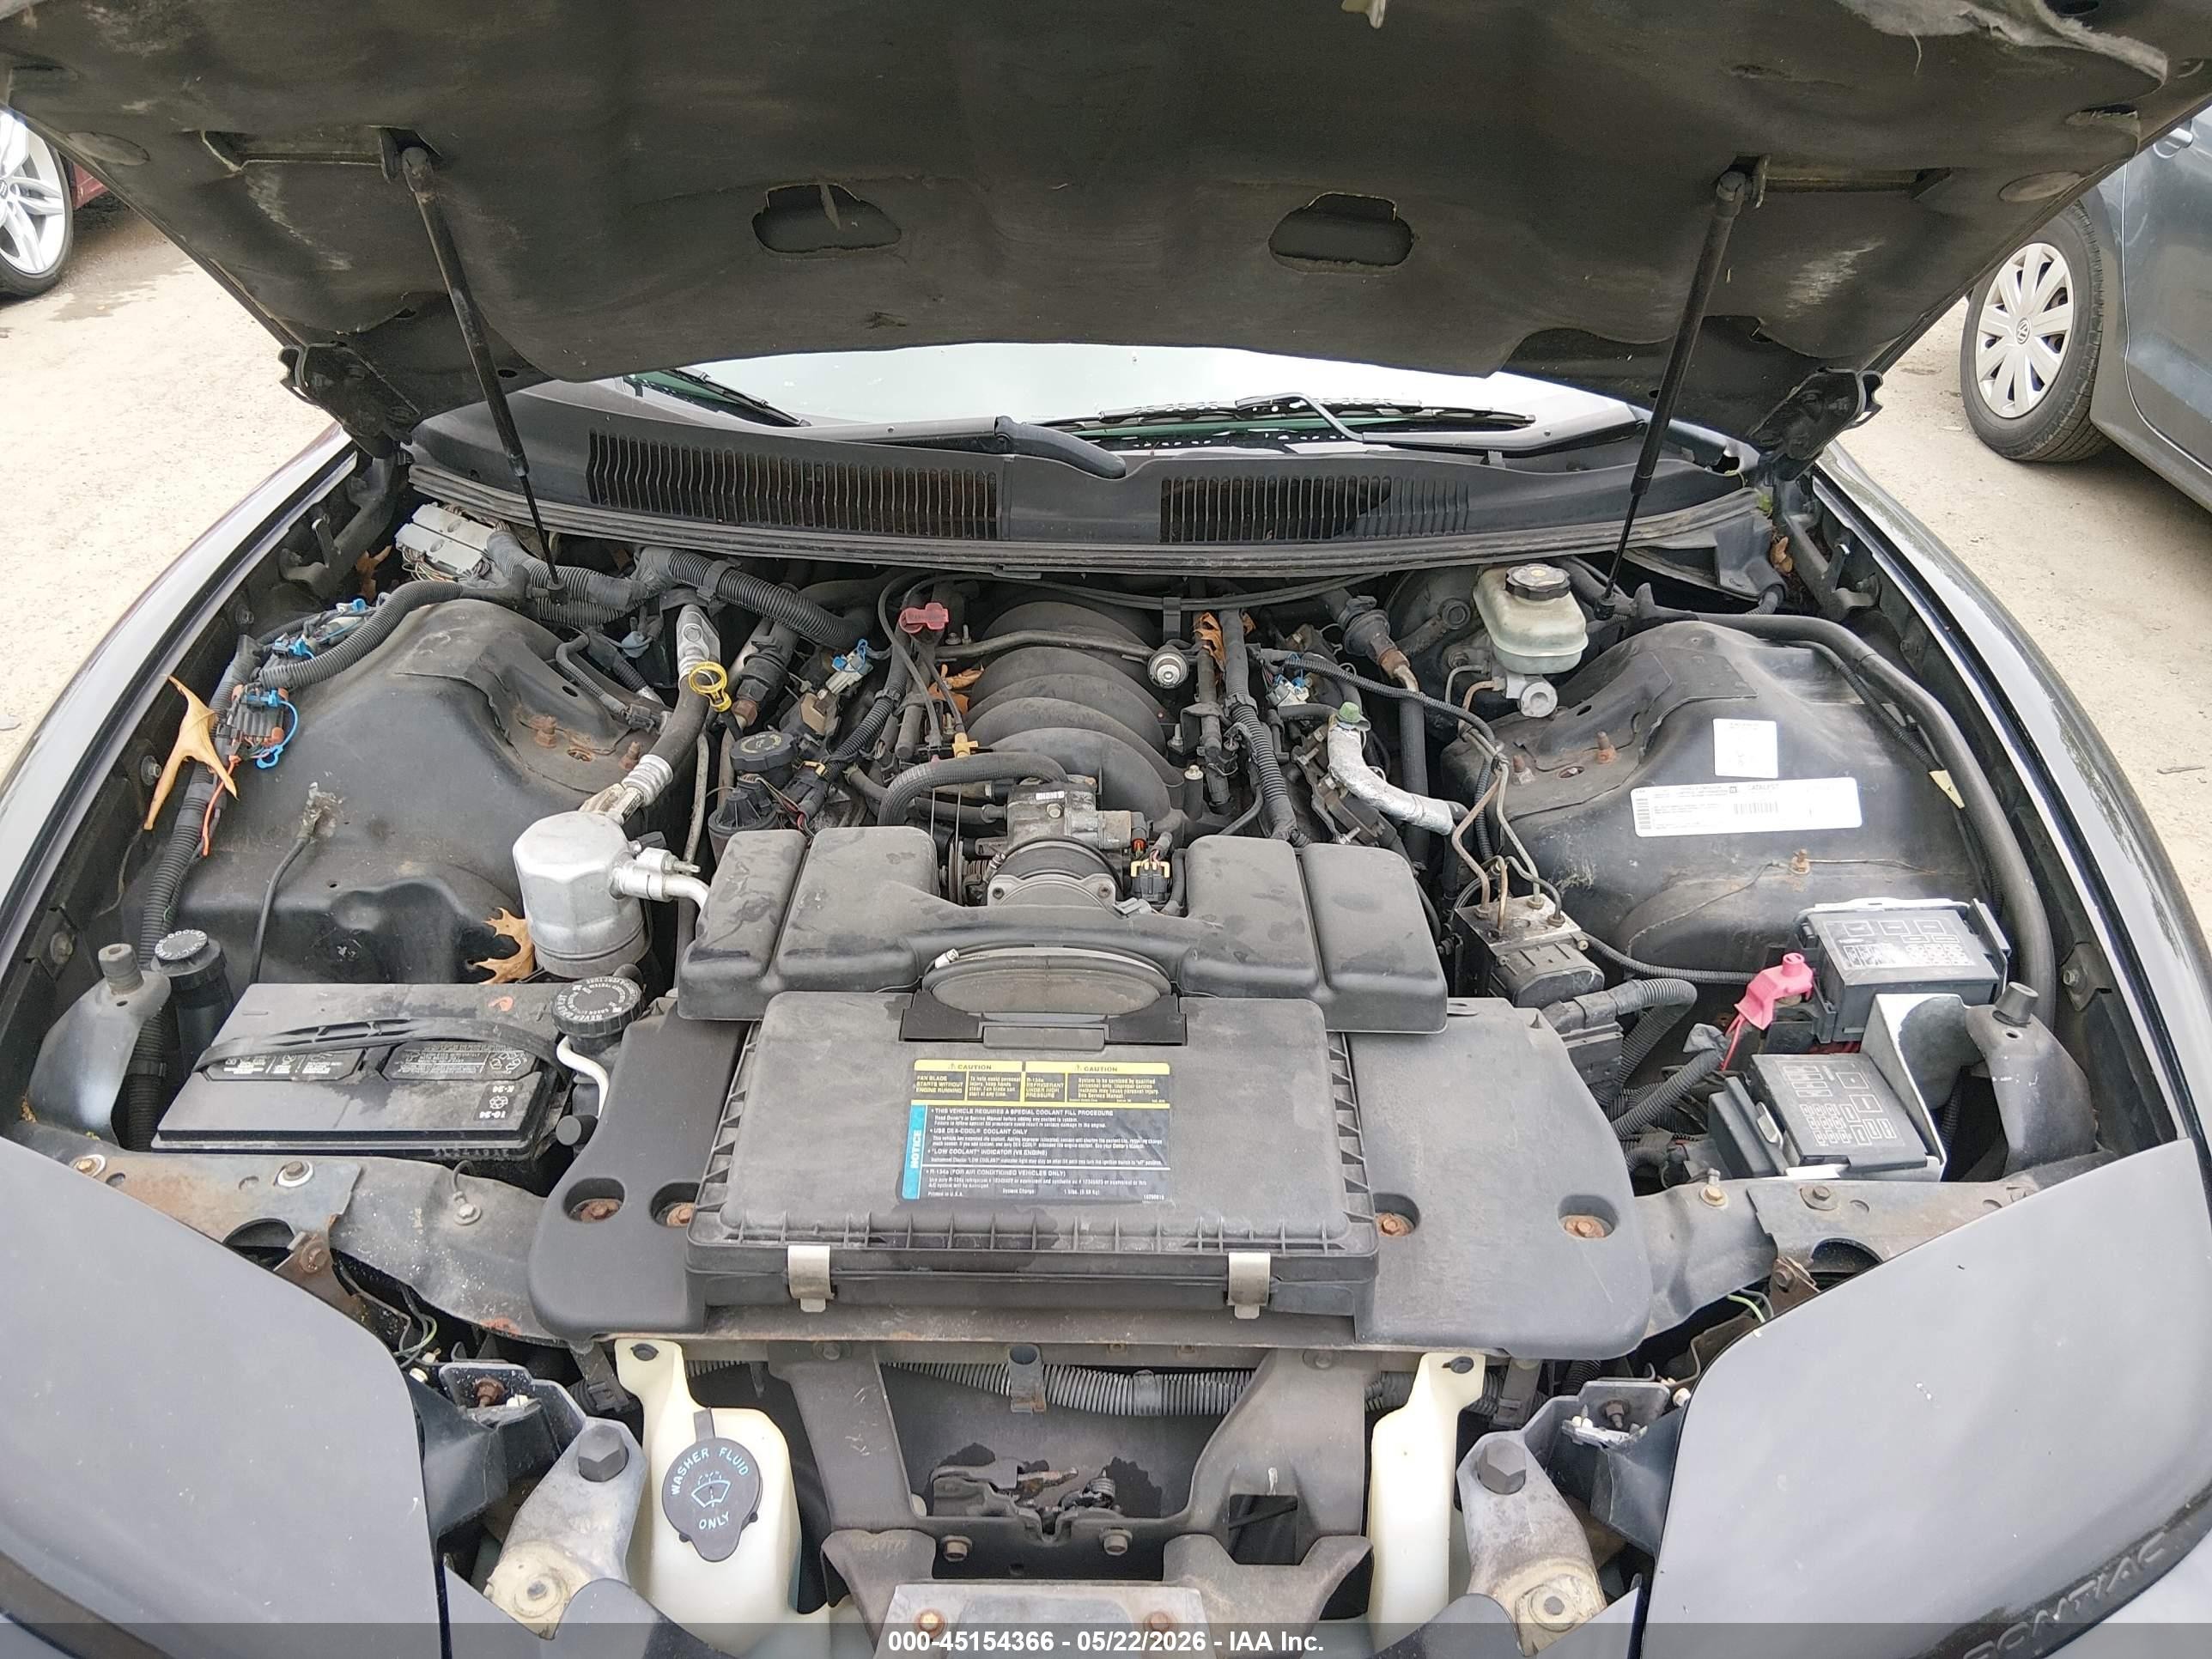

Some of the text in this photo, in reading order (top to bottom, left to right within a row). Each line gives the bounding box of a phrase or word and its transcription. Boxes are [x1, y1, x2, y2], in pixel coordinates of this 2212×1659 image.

[910, 1129, 922, 1169] NOTICE
[672, 1447, 750, 1495] WASHER FLUID
[698, 1511, 729, 1529] ONLY
[1963, 1531, 2166, 1659] PONTIAC
